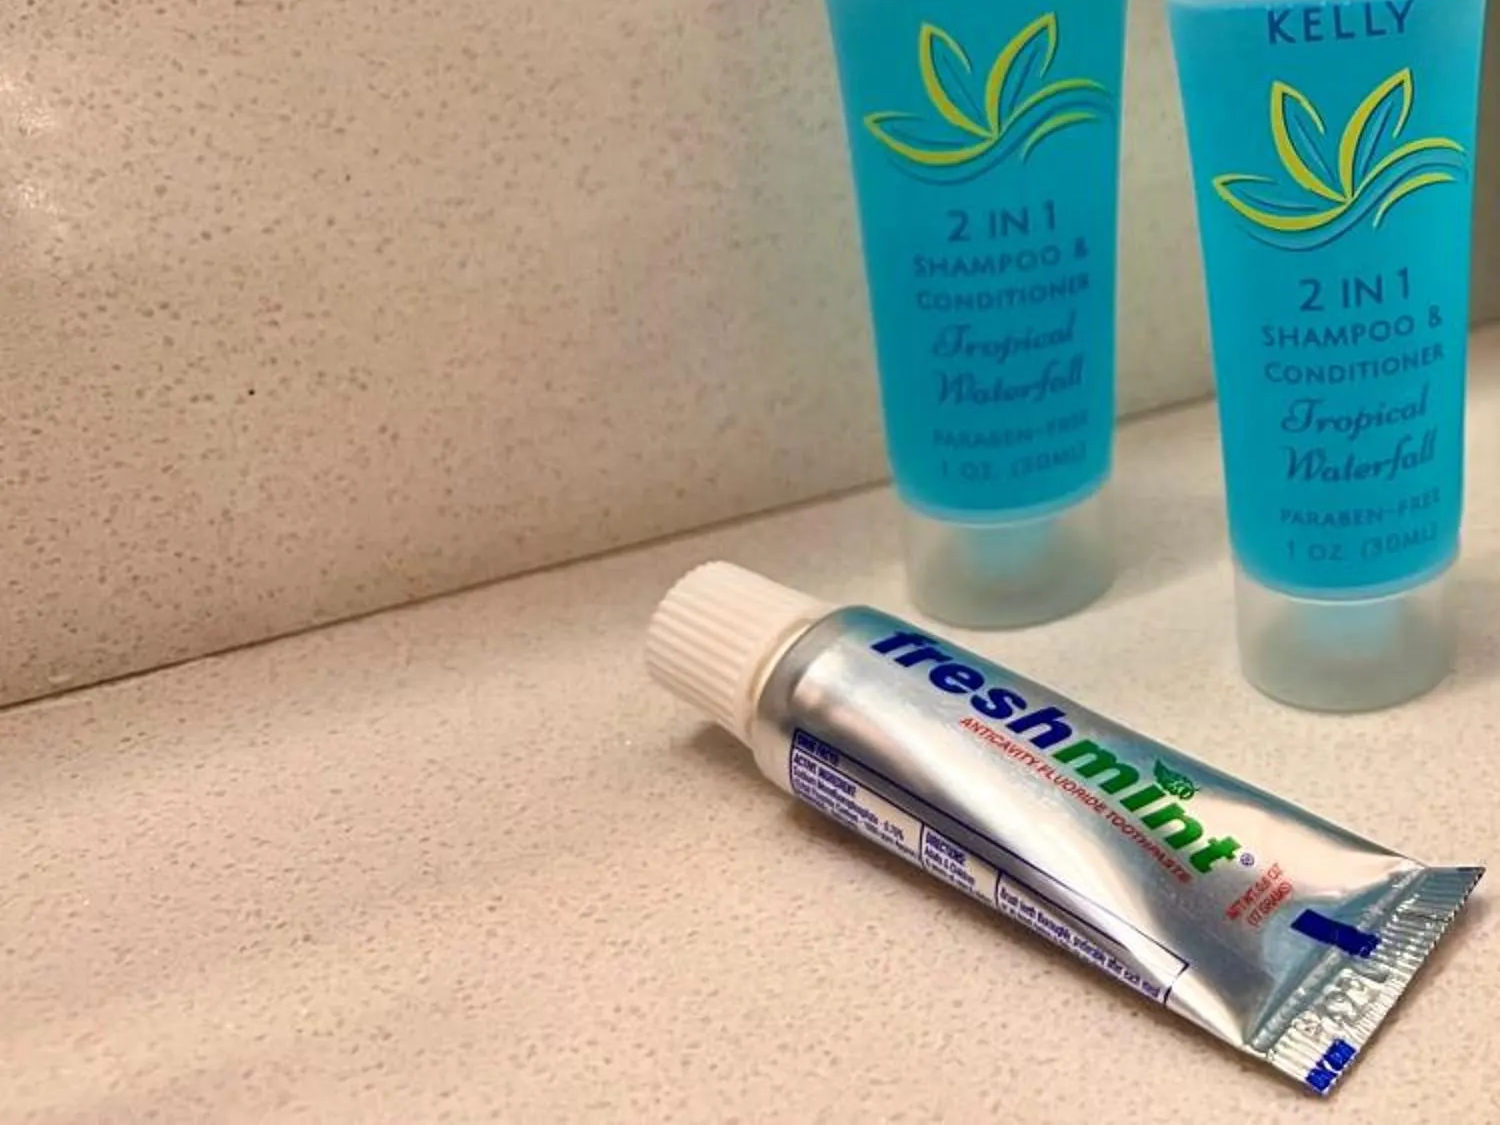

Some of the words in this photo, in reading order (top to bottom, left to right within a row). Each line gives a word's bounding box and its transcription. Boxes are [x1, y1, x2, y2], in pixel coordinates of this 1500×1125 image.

[947, 209, 971, 243] 2
[989, 206, 1030, 239] IN
[1043, 199, 1056, 231] 1
[913, 244, 1062, 278] SHAMPOO
[1073, 236, 1089, 261] &
[915, 272, 1090, 311] CONDITIONER
[1300, 278, 1324, 312] 2
[1341, 273, 1383, 309] IN
[1397, 266, 1410, 300] 1
[931, 309, 1076, 365] Tropical
[1261, 315, 1415, 348] SHAMPOO
[1428, 304, 1443, 329] &
[931, 353, 1085, 406] Waterfall
[1263, 343, 1444, 385] CONDITIONER
[1281, 381, 1429, 442] Tropical
[1280, 425, 1438, 483] Waterfall
[1279, 487, 1442, 528] PARABEN-FREE
[959, 716, 1039, 768] ANTICAVITY
[1038, 760, 1108, 815] FLUORIDE
[1104, 809, 1195, 884] TOOTHPASTE
